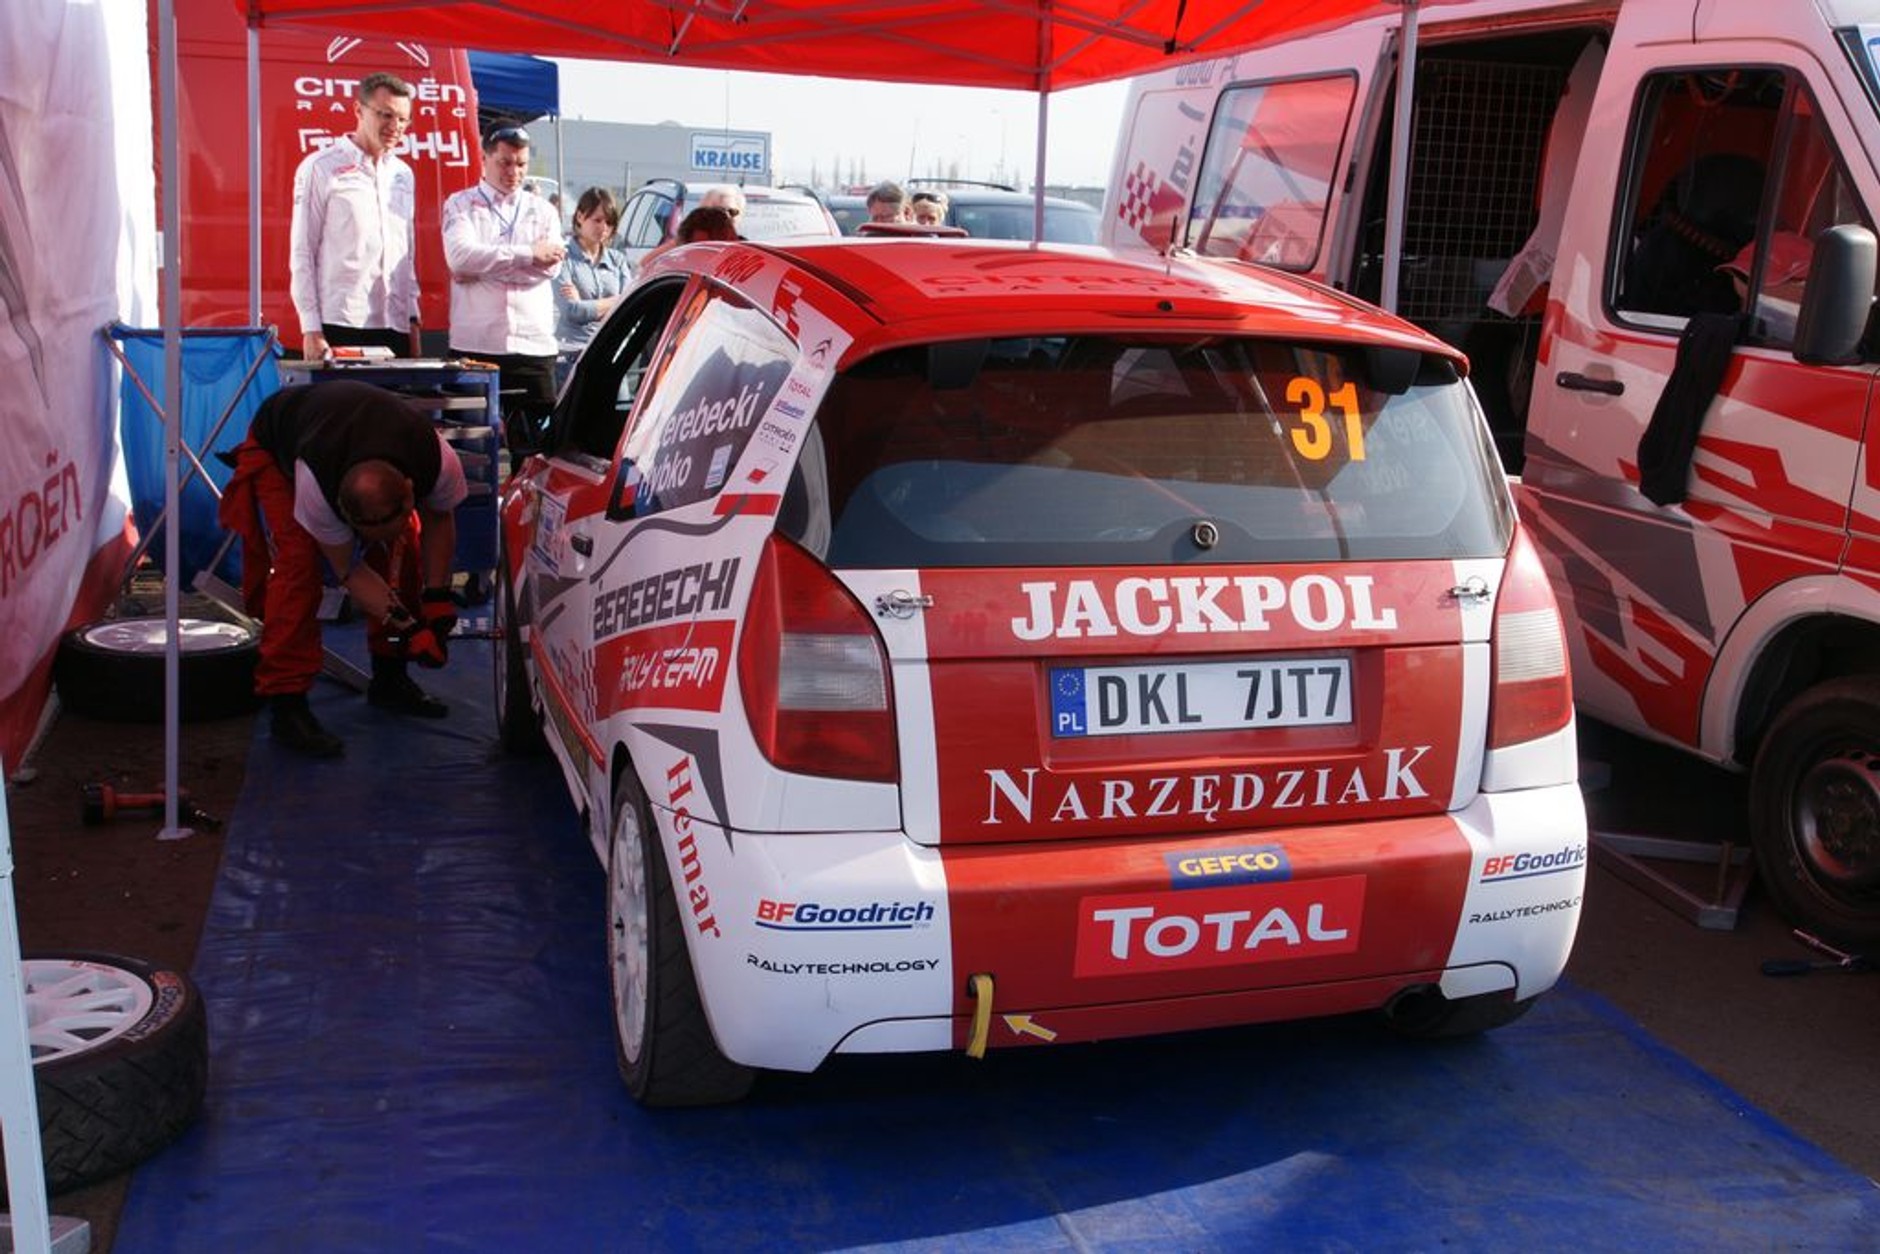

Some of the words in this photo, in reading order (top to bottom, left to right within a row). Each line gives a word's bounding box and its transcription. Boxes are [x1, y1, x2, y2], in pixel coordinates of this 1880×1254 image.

[294, 77, 466, 103] CITËN
[296, 101, 467, 117] RANG
[695, 150, 762, 169] KRAUSE
[661, 380, 765, 448] erebecki
[1286, 376, 1366, 461] 31
[1011, 575, 1398, 640] JACKPOL
[1098, 672, 1202, 727] DKL
[1237, 667, 1342, 721] 7JT7
[1058, 712, 1084, 732] PL
[981, 745, 1432, 824] NARZĘDZIAK
[666, 757, 721, 938] Hemar
[1178, 852, 1280, 877] GEFCO
[757, 900, 935, 924] BFGoodrich
[1093, 903, 1348, 960] TOTAL
[747, 954, 939, 974] RALLYTECHNOLOGY
